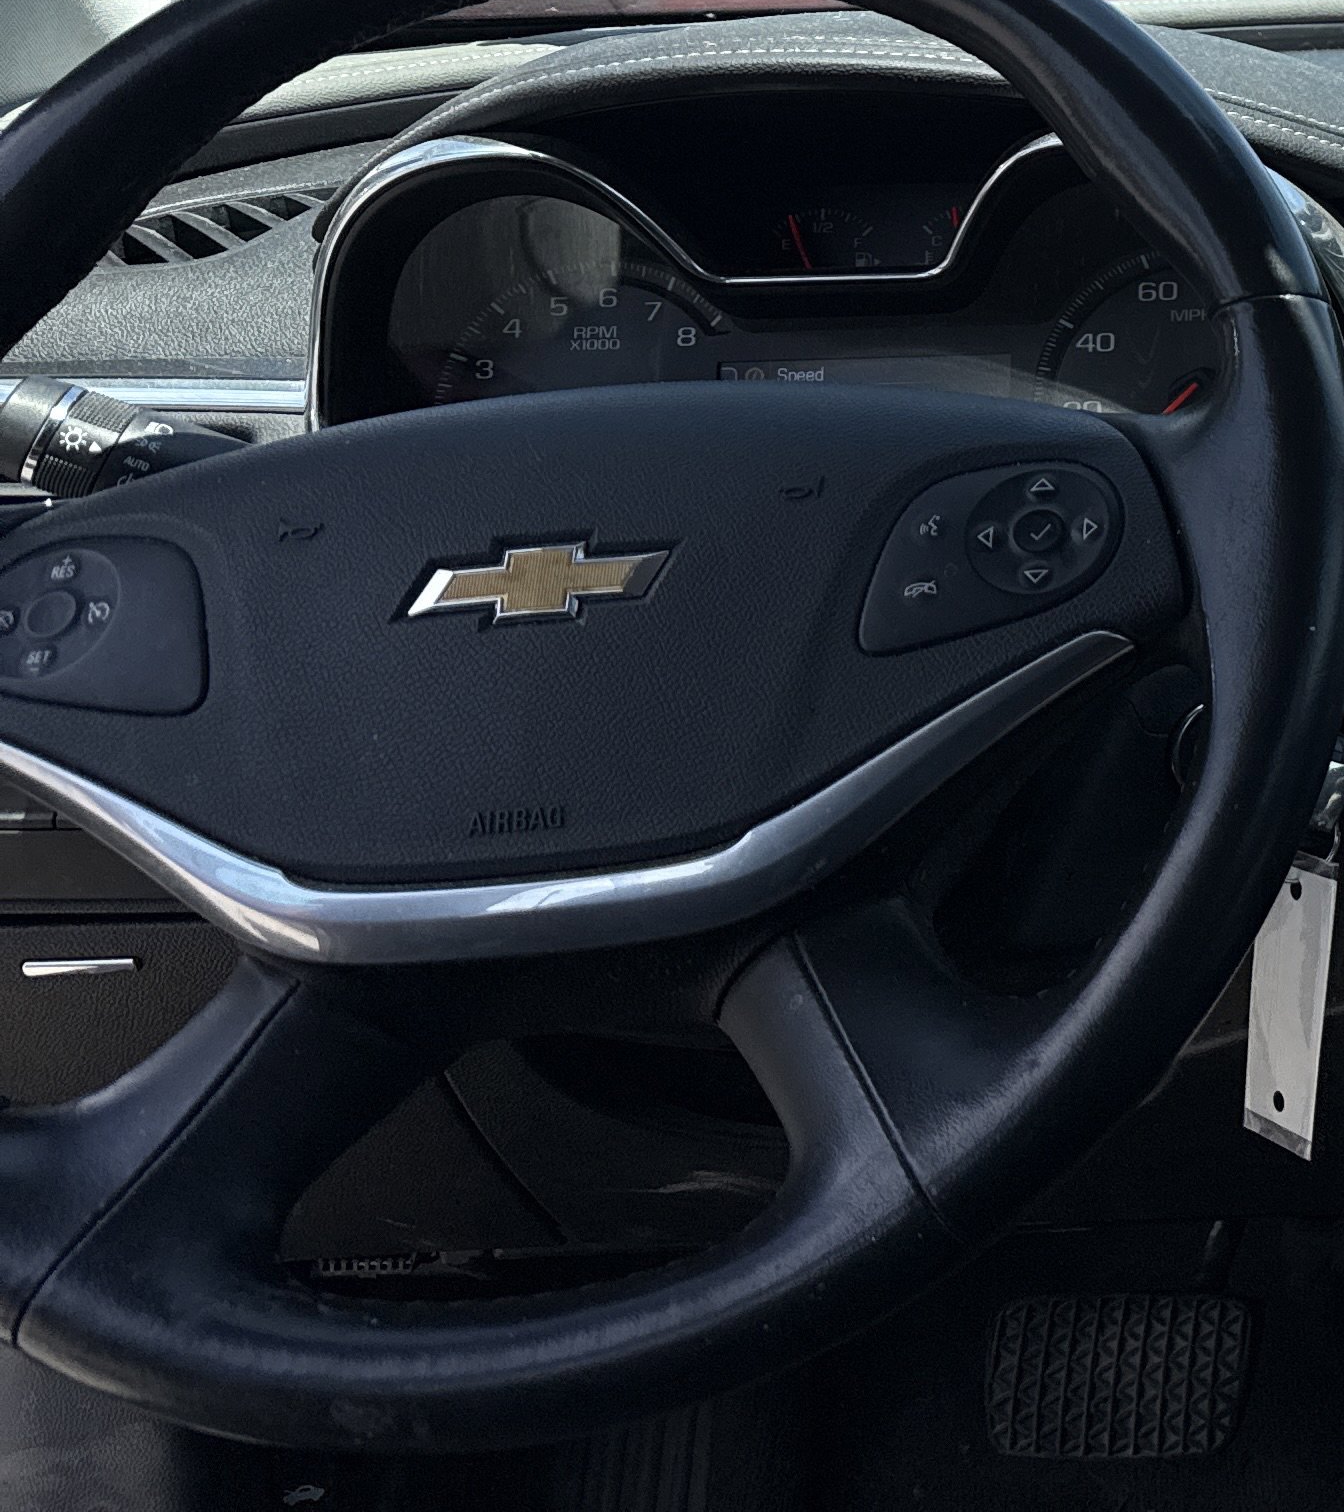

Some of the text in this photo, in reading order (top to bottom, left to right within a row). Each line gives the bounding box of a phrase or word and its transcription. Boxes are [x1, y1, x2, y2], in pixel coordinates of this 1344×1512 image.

[781, 239, 792, 251] E
[598, 288, 618, 308] 6
[1137, 281, 1179, 303] 60
[549, 296, 569, 317] 5
[643, 301, 663, 322] 7
[502, 318, 523, 339] 4
[572, 326, 618, 339] RPM
[676, 327, 697, 347] 8
[1074, 332, 1116, 353] 40
[475, 359, 495, 380] 3
[777, 366, 825, 383] Speed
[123, 455, 151, 472] AUTO
[51, 564, 76, 580] RES
[26, 650, 52, 665] SET
[469, 806, 565, 838] AIRBAG
